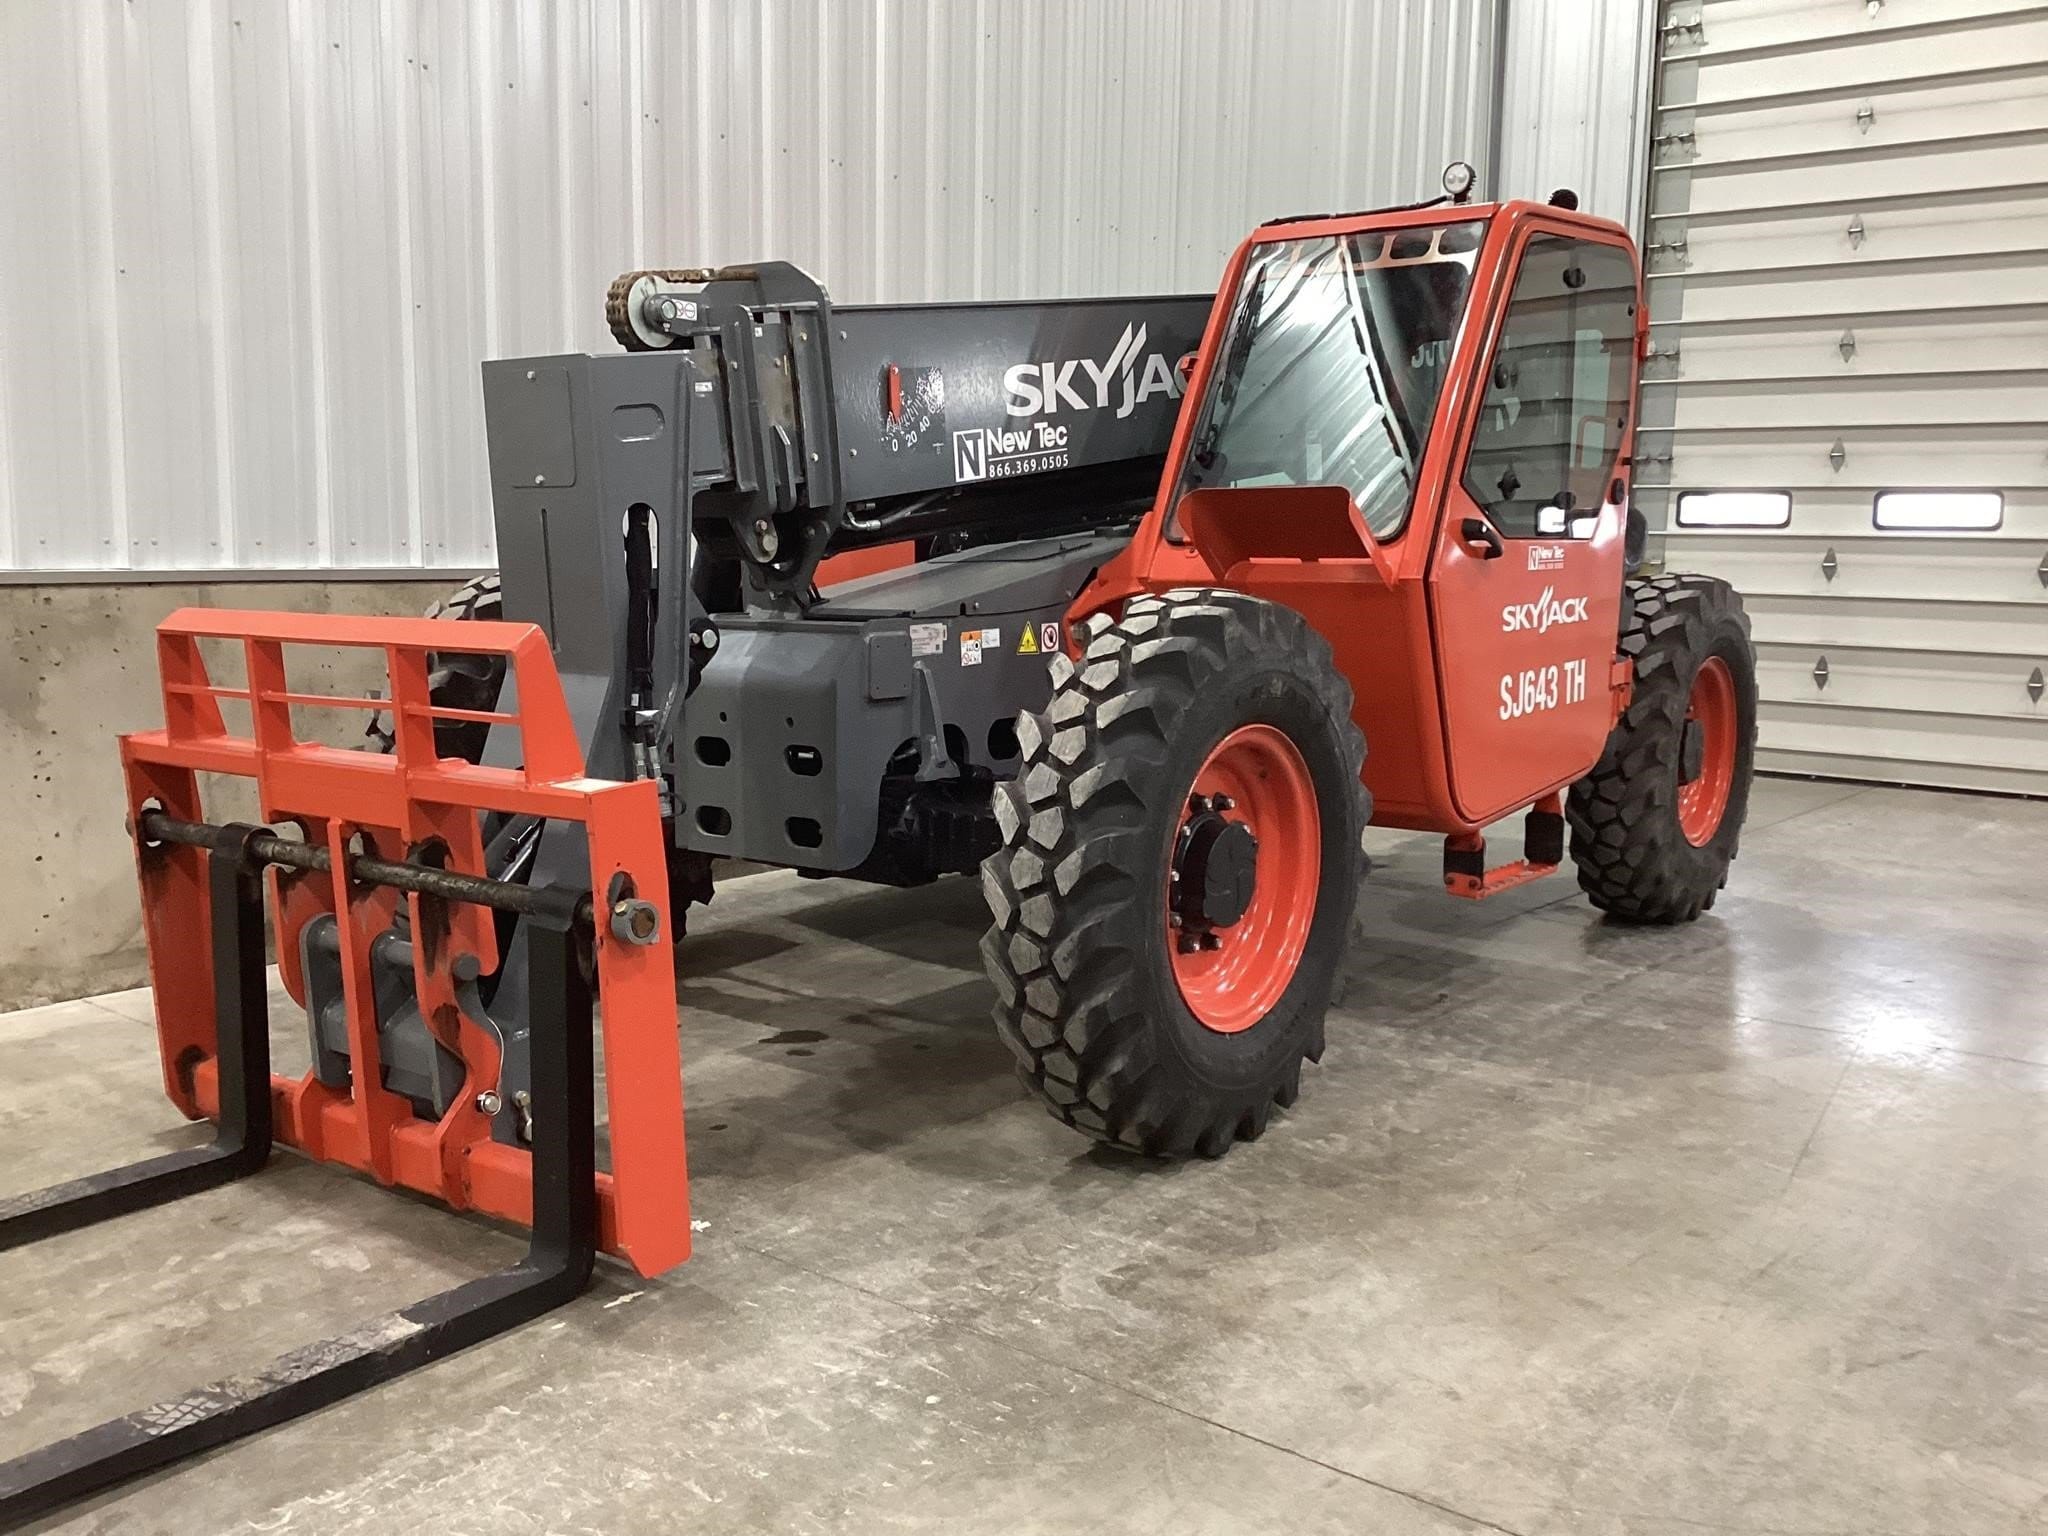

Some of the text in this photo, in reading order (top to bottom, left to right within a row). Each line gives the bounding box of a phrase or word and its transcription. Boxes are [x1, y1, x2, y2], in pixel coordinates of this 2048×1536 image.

[892, 439, 899, 452] 0
[906, 431, 917, 447] 20
[987, 422, 1068, 455] New Tec
[989, 454, 1069, 478] 866.369.0505
[1502, 585, 1588, 634] SKYJACK
[1500, 659, 1586, 720] SJ643 TH
